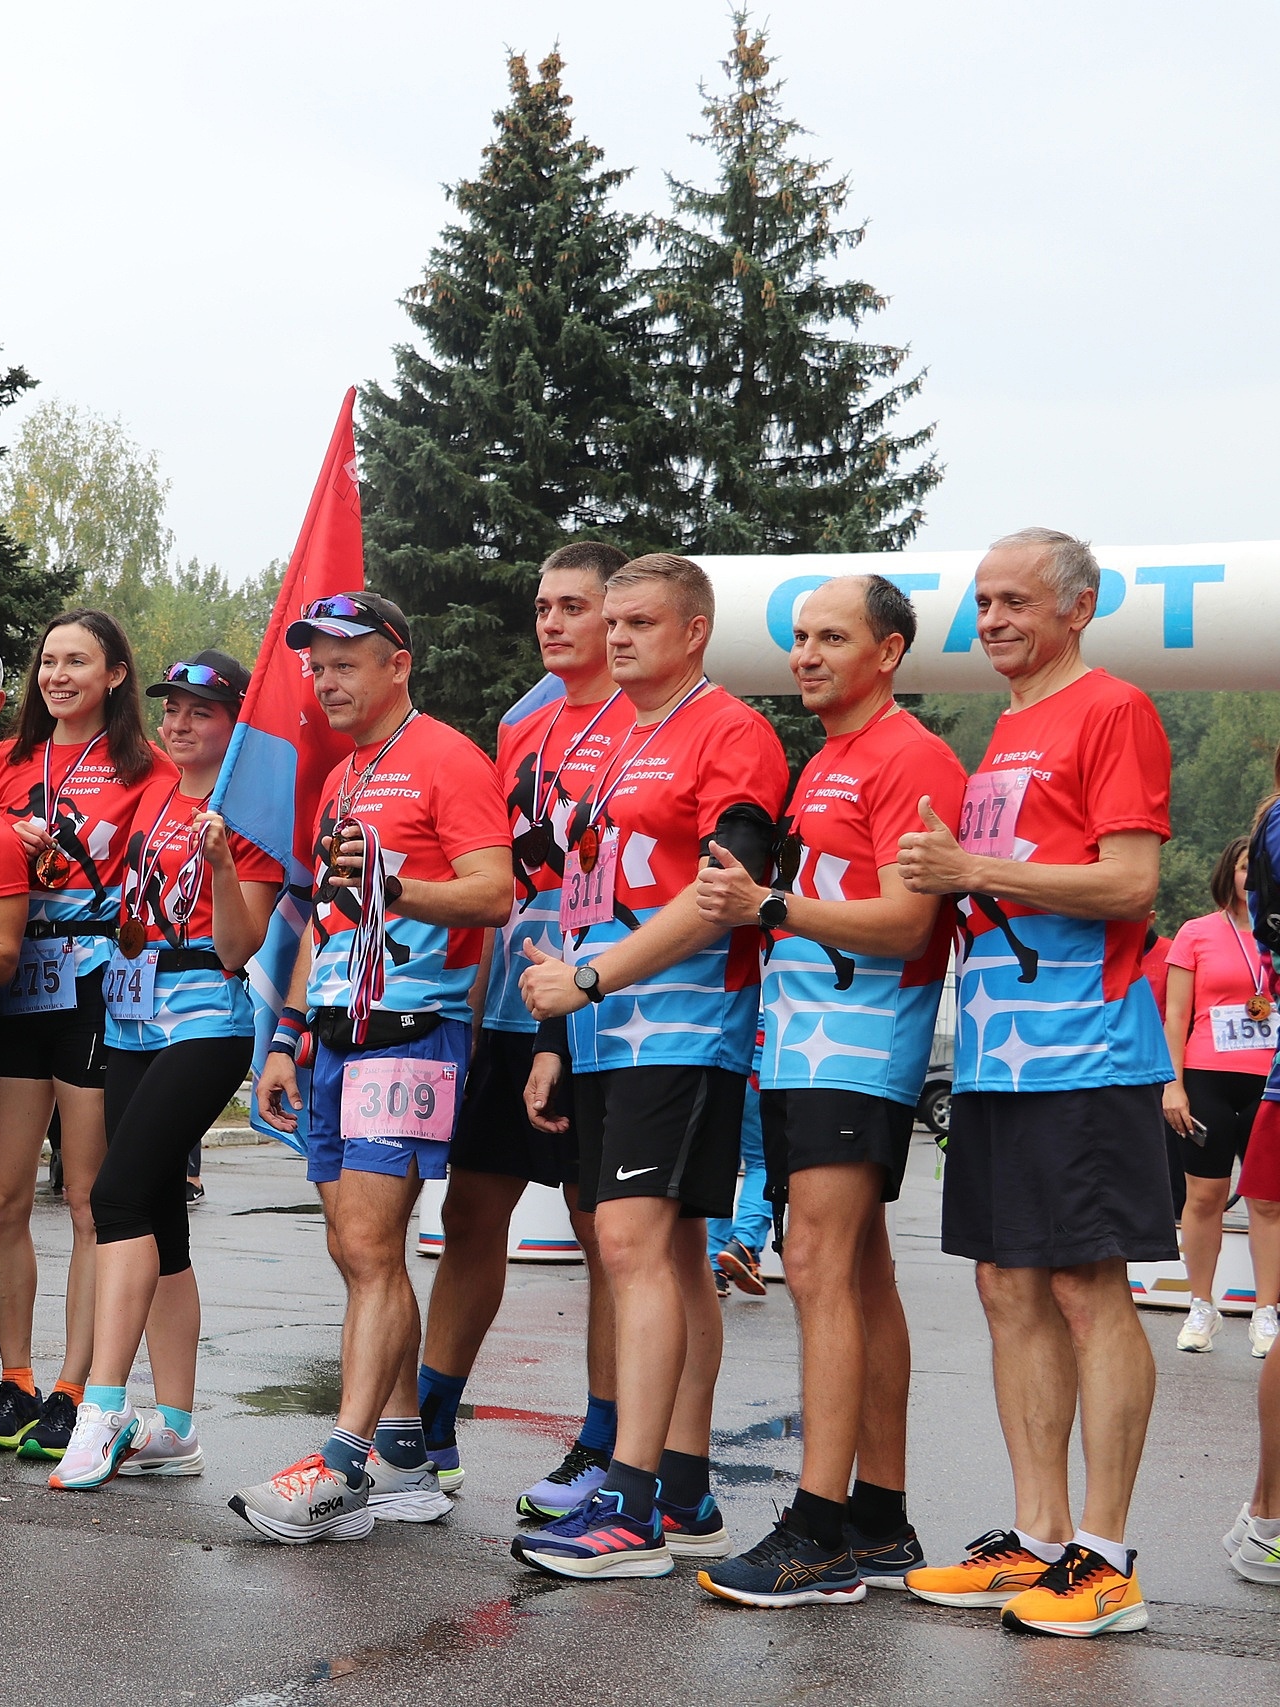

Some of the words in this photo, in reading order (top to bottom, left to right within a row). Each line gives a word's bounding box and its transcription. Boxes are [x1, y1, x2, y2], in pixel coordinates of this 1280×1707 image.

[992, 752, 1002, 765] И
[61, 786, 101, 795] ближе
[960, 798, 1007, 842] 317
[569, 866, 605, 911] 311
[9, 960, 61, 998] 275
[107, 967, 143, 1003] 274
[1225, 1017, 1272, 1040] 156
[360, 1081, 435, 1120] 309
[374, 1137, 403, 1149] Columbia
[309, 1495, 344, 1521] HOKA
